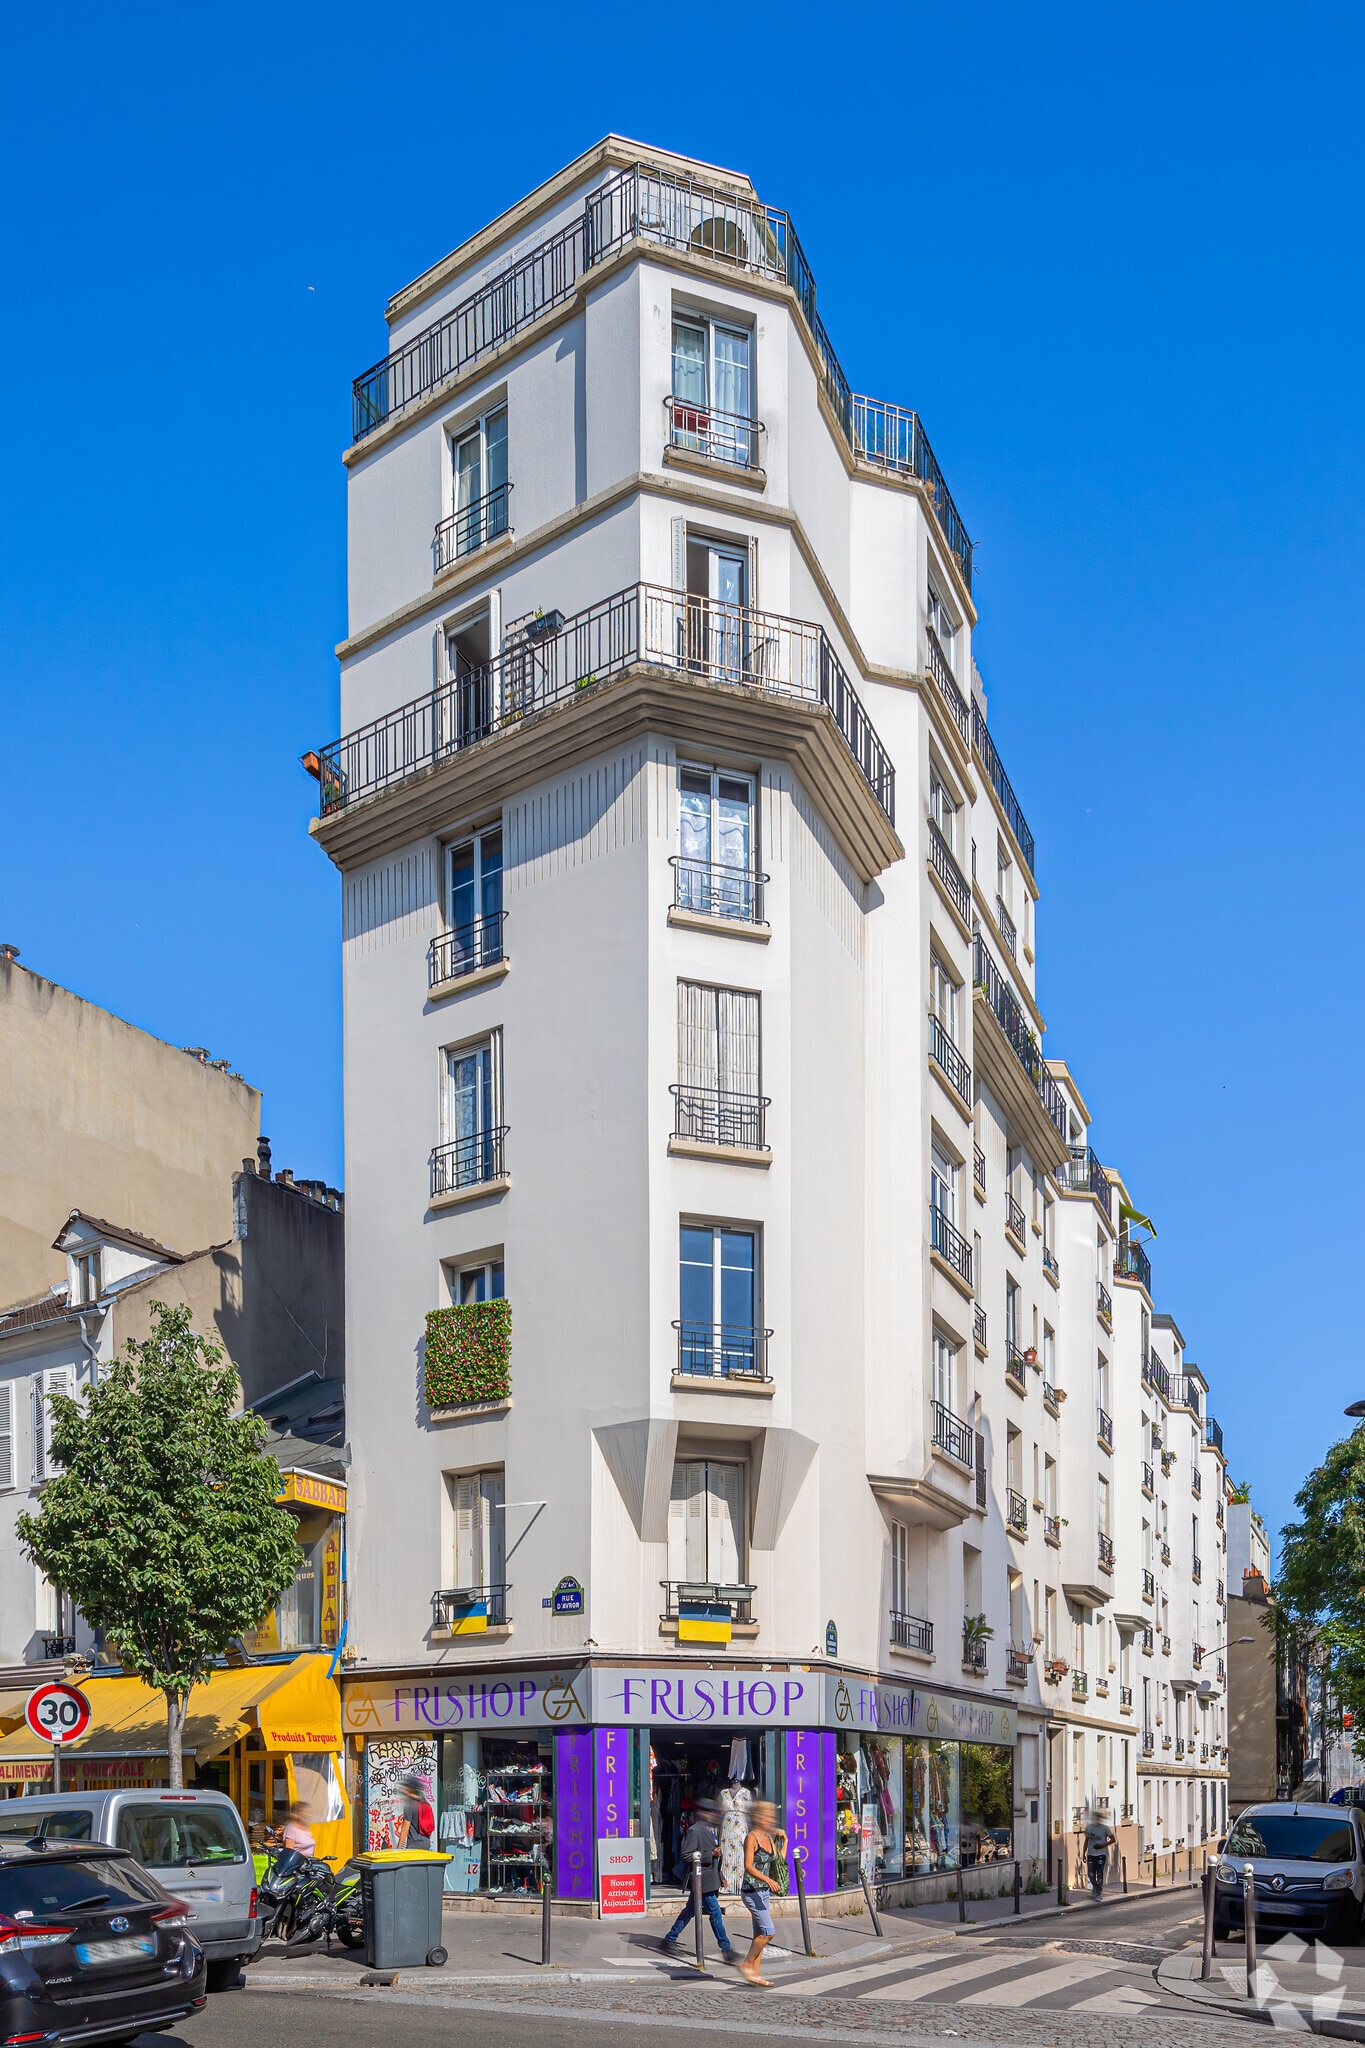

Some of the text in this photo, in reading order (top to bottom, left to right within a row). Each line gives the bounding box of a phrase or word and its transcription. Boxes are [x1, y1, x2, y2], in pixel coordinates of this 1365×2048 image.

[295, 1477, 345, 1508] SABBAH
[296, 1572, 315, 1581] ques
[324, 1538, 338, 1645] ABBAH
[561, 1594, 575, 1602] RUE
[556, 1602, 580, 1610] D'AVRON
[381, 1680, 537, 1727] FRISHOP
[604, 1678, 805, 1722] FRISHOP
[855, 1688, 921, 1730] FRISHOP
[40, 1700, 79, 1726] 30
[270, 1731, 338, 1745] Produits Turques
[0, 1761, 145, 1779] ALIMENTAON ORIENTALE
[605, 1731, 619, 1839] FRISH
[568, 1731, 584, 1893] FRISHOP
[609, 1855, 634, 1864] SHOP
[610, 1879, 635, 1887] Nouvel
[608, 1889, 638, 1898] arrivage
[602, 1898, 644, 1908] Aujourd'hui
